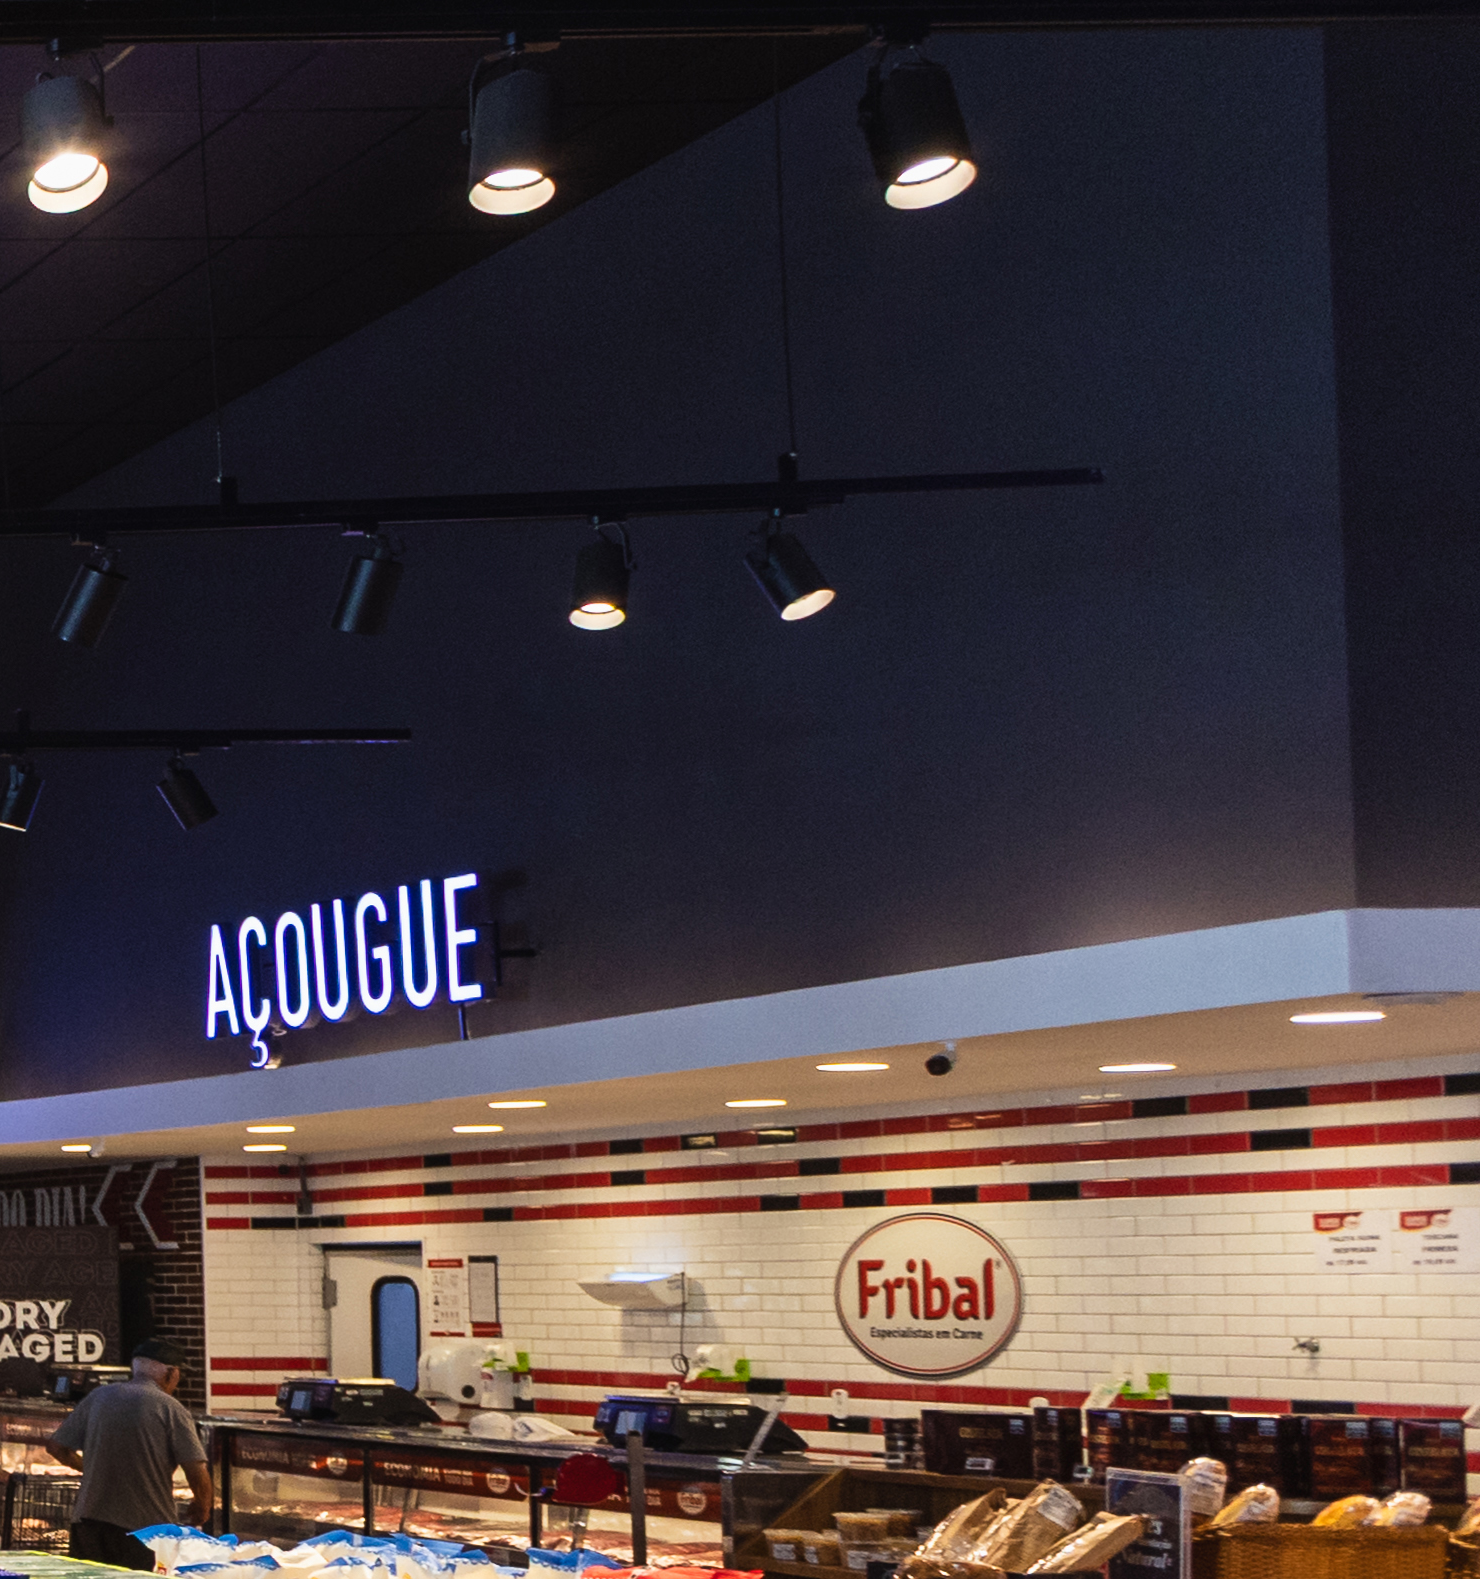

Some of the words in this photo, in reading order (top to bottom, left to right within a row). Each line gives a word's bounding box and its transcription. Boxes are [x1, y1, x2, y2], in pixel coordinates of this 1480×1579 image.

[207, 873, 482, 1068] AÇOUGUE
[858, 1258, 995, 1320] Fribal
[870, 1327, 934, 1340] Especialistas
[936, 1330, 951, 1338] em
[953, 1328, 983, 1339] Carne
